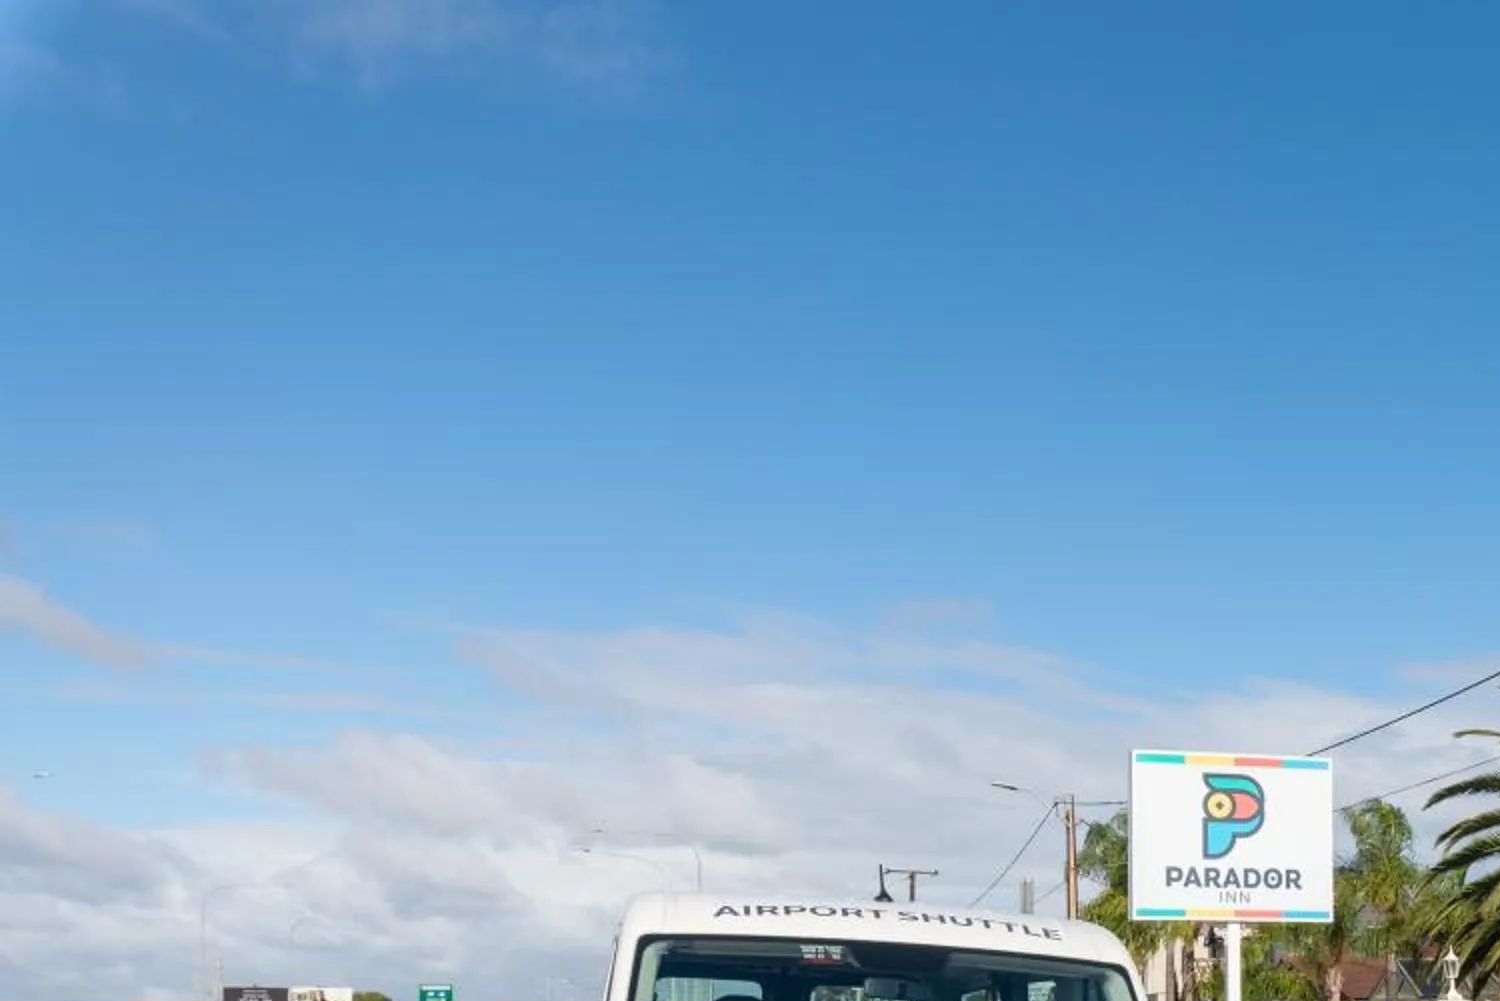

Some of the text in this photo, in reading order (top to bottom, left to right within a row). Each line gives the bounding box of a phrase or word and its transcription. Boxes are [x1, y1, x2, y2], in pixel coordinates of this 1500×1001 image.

[1165, 866, 1303, 890] PARADOR
[1219, 891, 1252, 904] INN
[713, 905, 1063, 941] AIRPORT SHUTTLE
